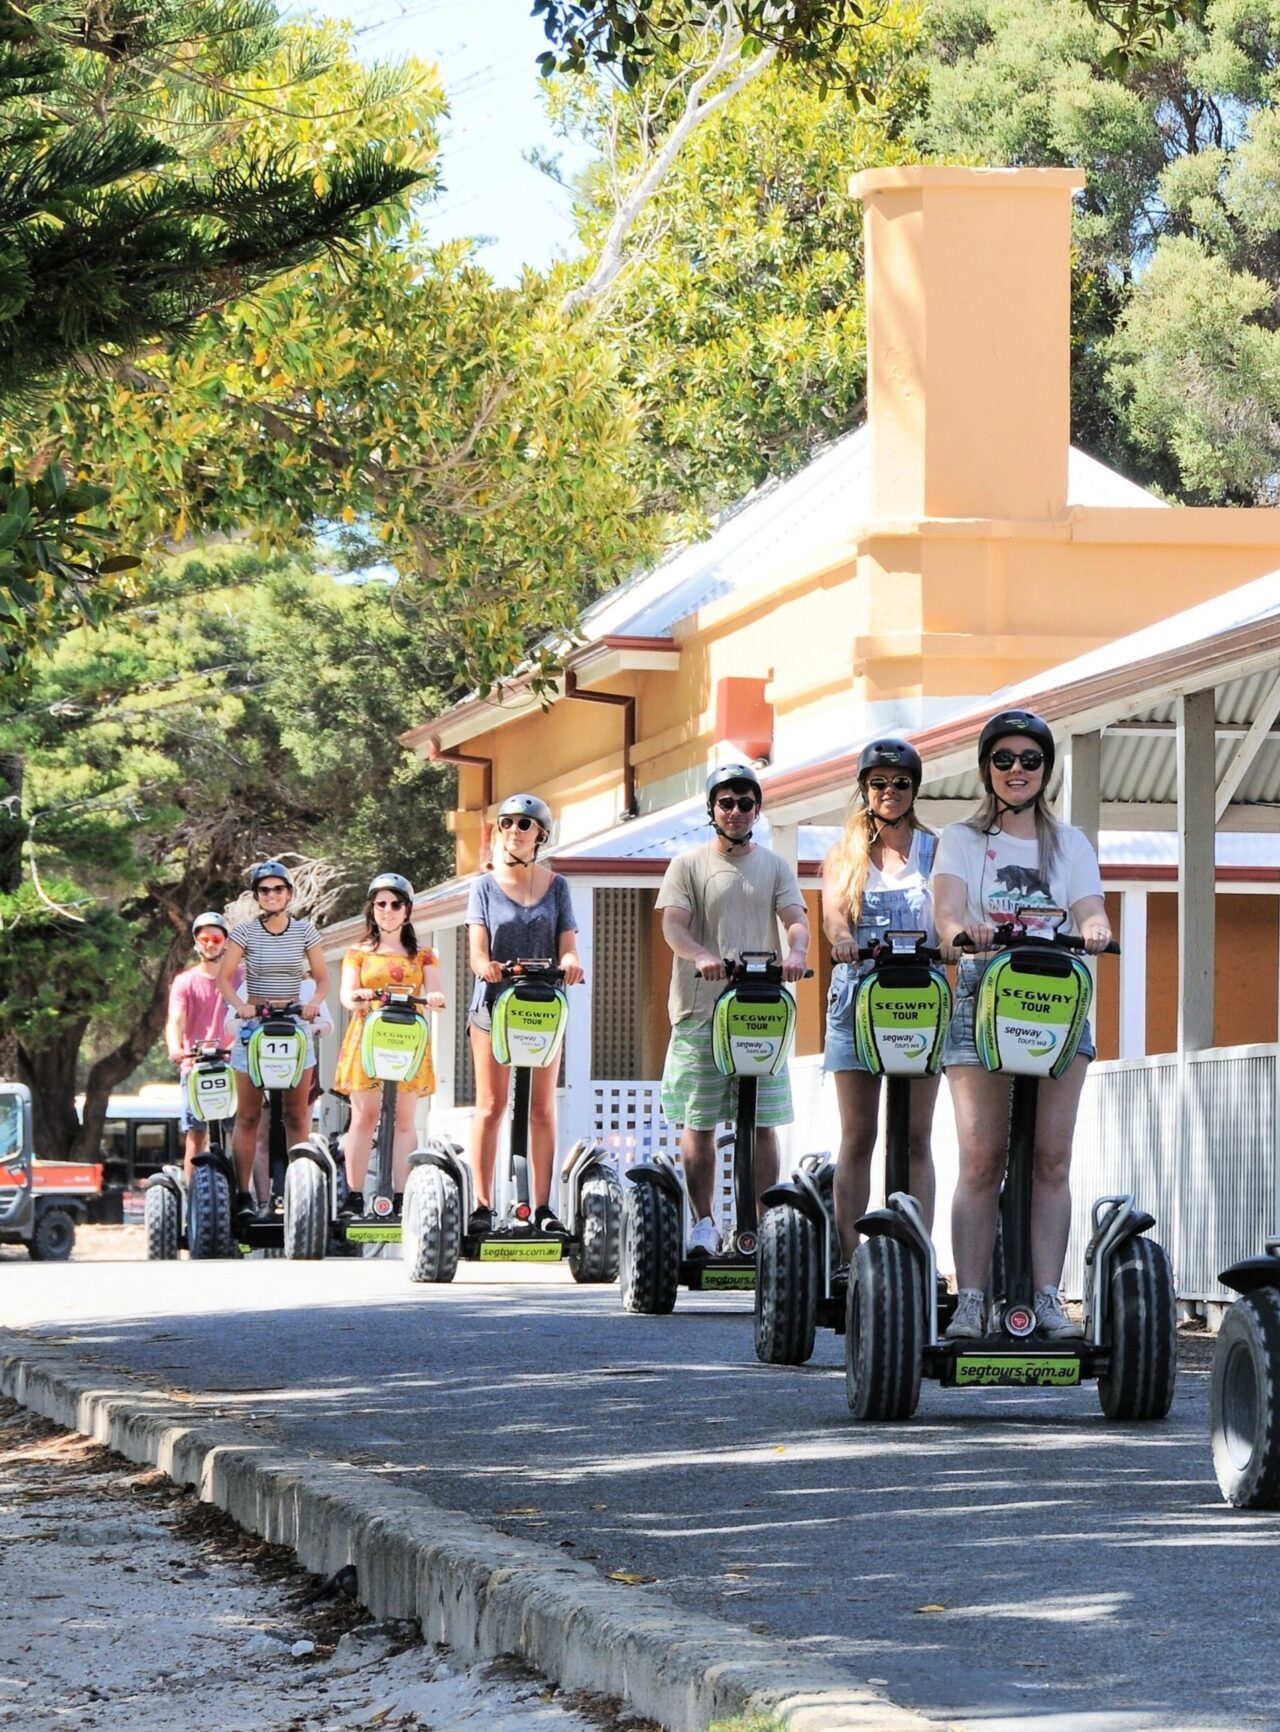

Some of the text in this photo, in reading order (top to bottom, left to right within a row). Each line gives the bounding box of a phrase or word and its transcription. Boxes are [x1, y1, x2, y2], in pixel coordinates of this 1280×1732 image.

[1002, 988, 1073, 1004] SEGWAY
[875, 1002, 937, 1010] SEGWAY
[1021, 1001, 1051, 1014] TOUR
[510, 1009, 557, 1019] SEGWAY
[732, 1014, 784, 1022] SEGWAY
[893, 1012, 918, 1020] TOUR
[376, 1031, 416, 1040] SEGWAY
[1004, 1026, 1042, 1039] segway
[882, 1034, 914, 1043] segway
[1018, 1037, 1036, 1046] tours
[266, 1043, 289, 1054] 11
[201, 1079, 226, 1090] 09
[482, 1247, 560, 1257] segtours.com.au
[960, 1364, 1076, 1378] segtours.com.au
